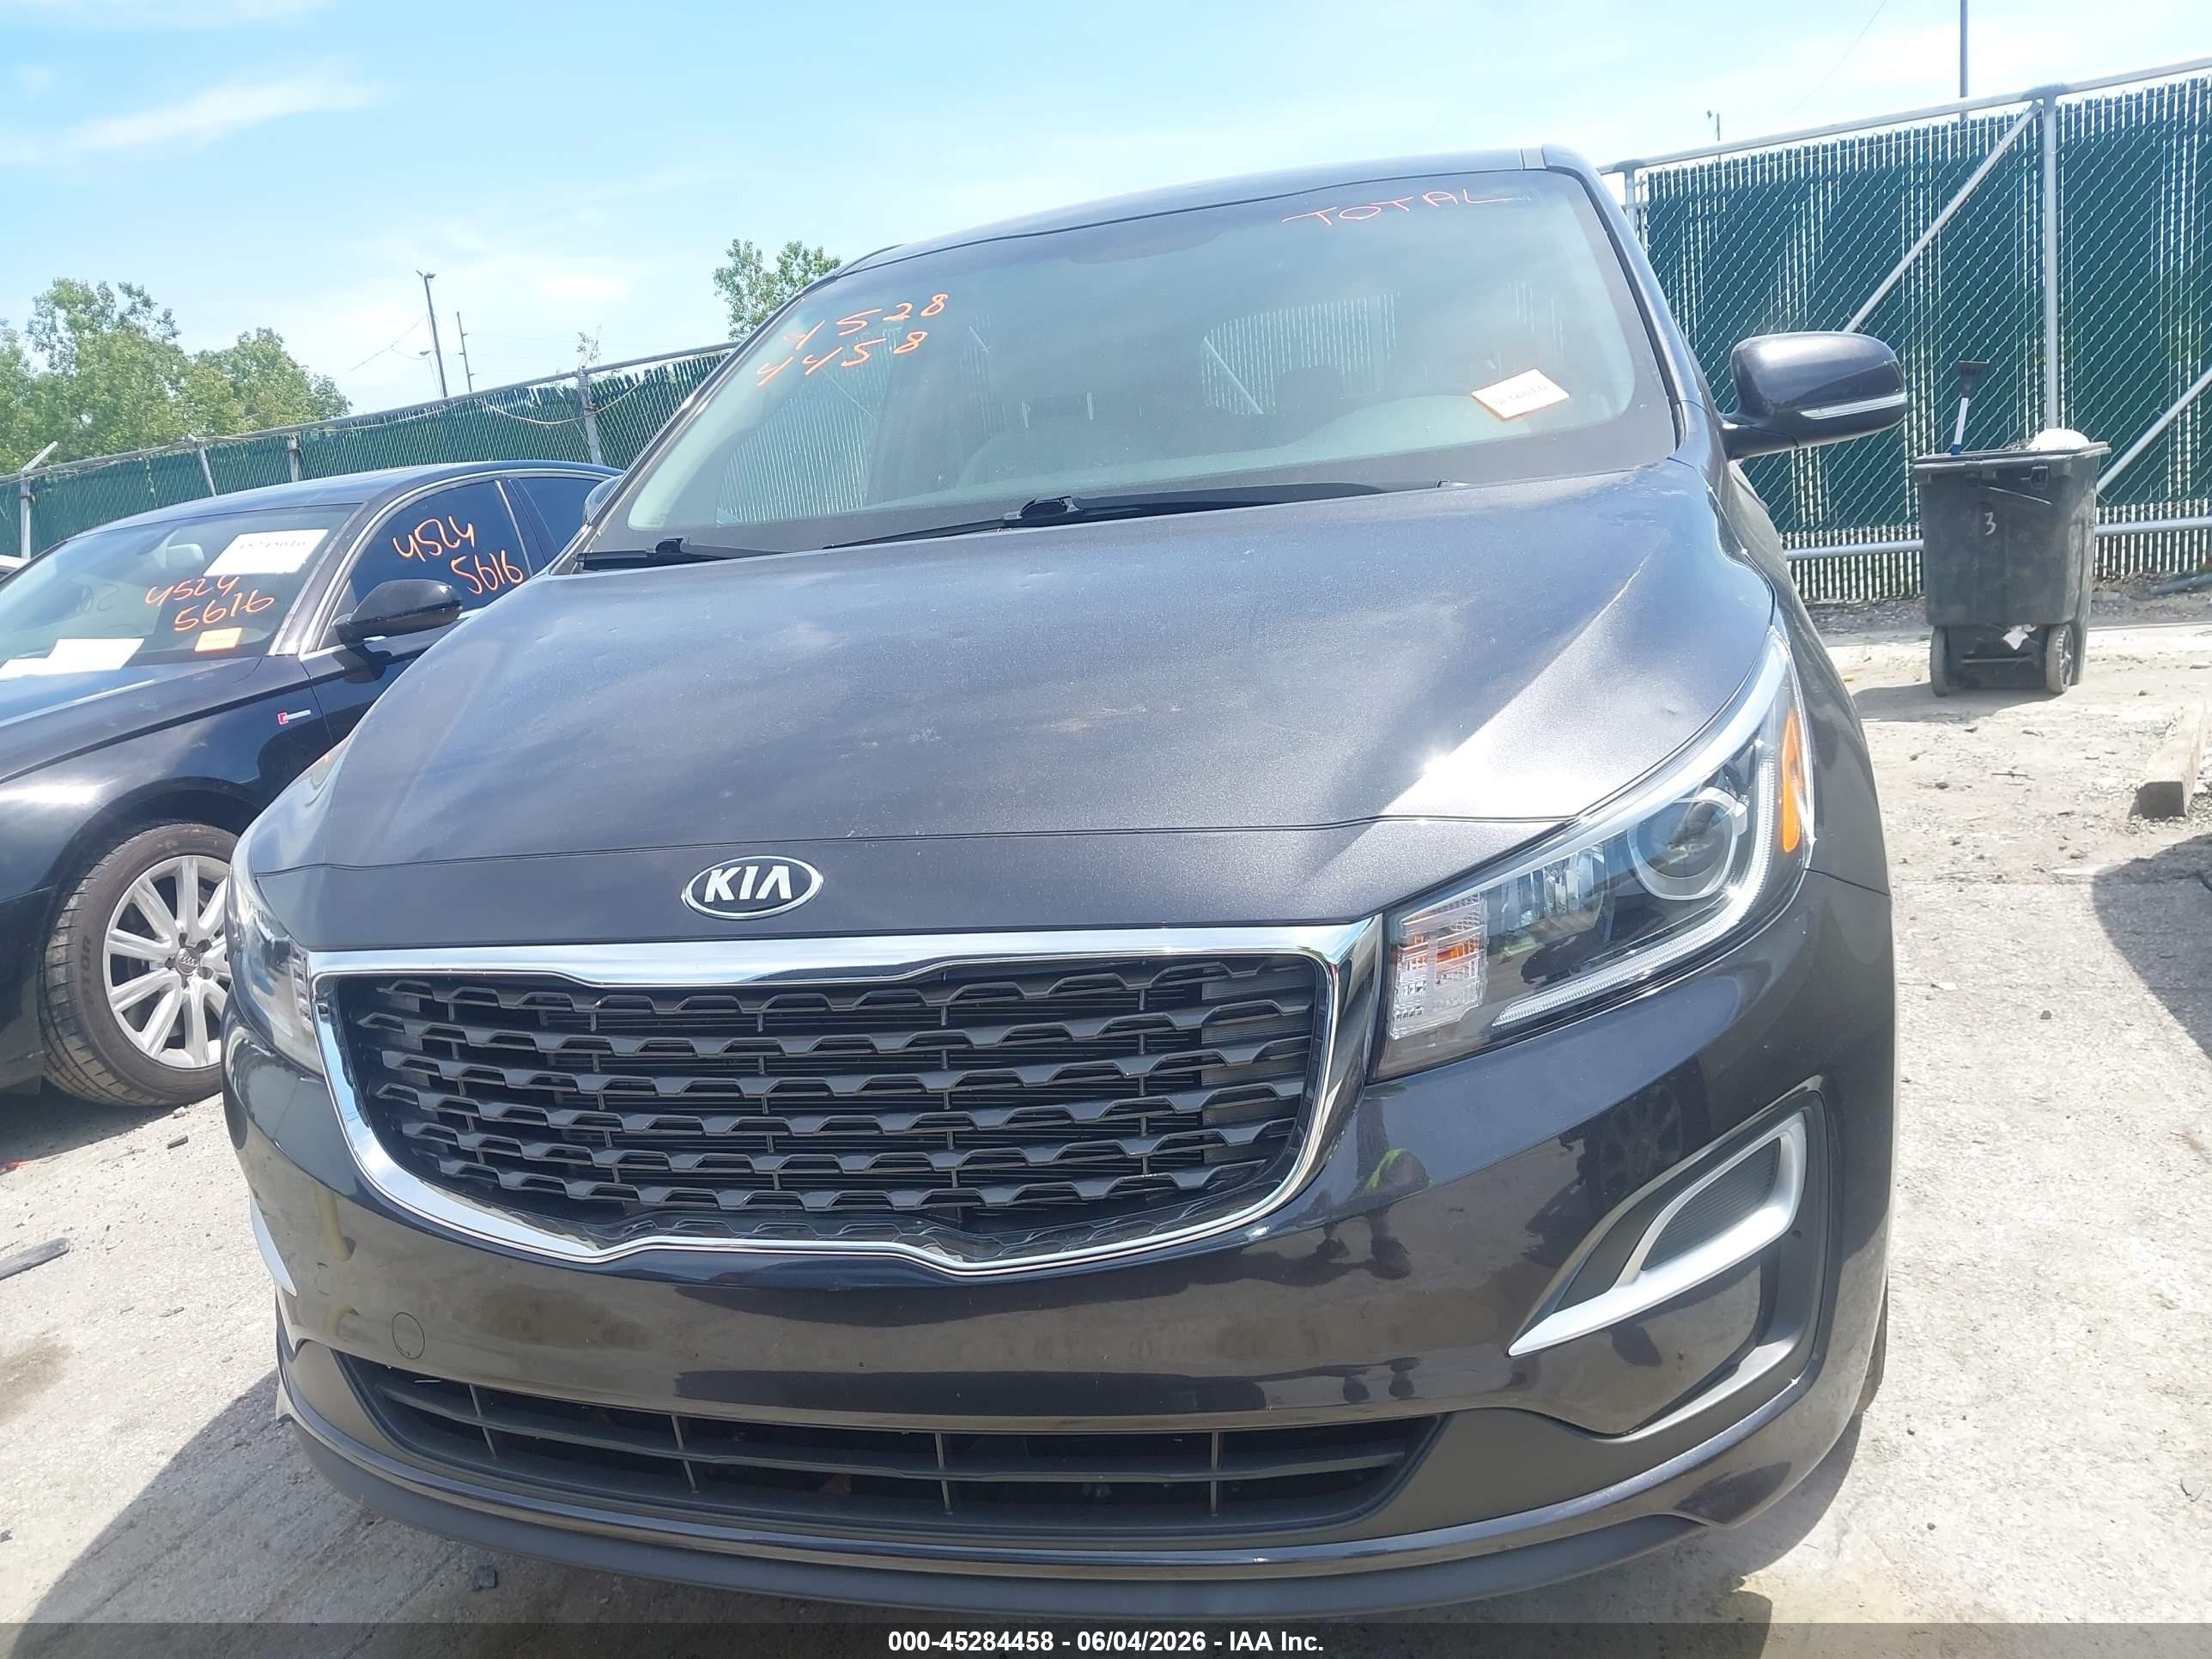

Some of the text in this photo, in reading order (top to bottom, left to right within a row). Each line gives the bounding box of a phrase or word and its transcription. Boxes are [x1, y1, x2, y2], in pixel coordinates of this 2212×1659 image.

[1281, 188, 1522, 227] TOTAL
[756, 331, 928, 387] 4458
[392, 514, 475, 562] 4524
[1984, 512, 1996, 536] 3
[144, 574, 240, 607] 4524
[450, 550, 524, 595] 5616
[173, 589, 275, 632] 5616
[704, 865, 793, 902] KIA
